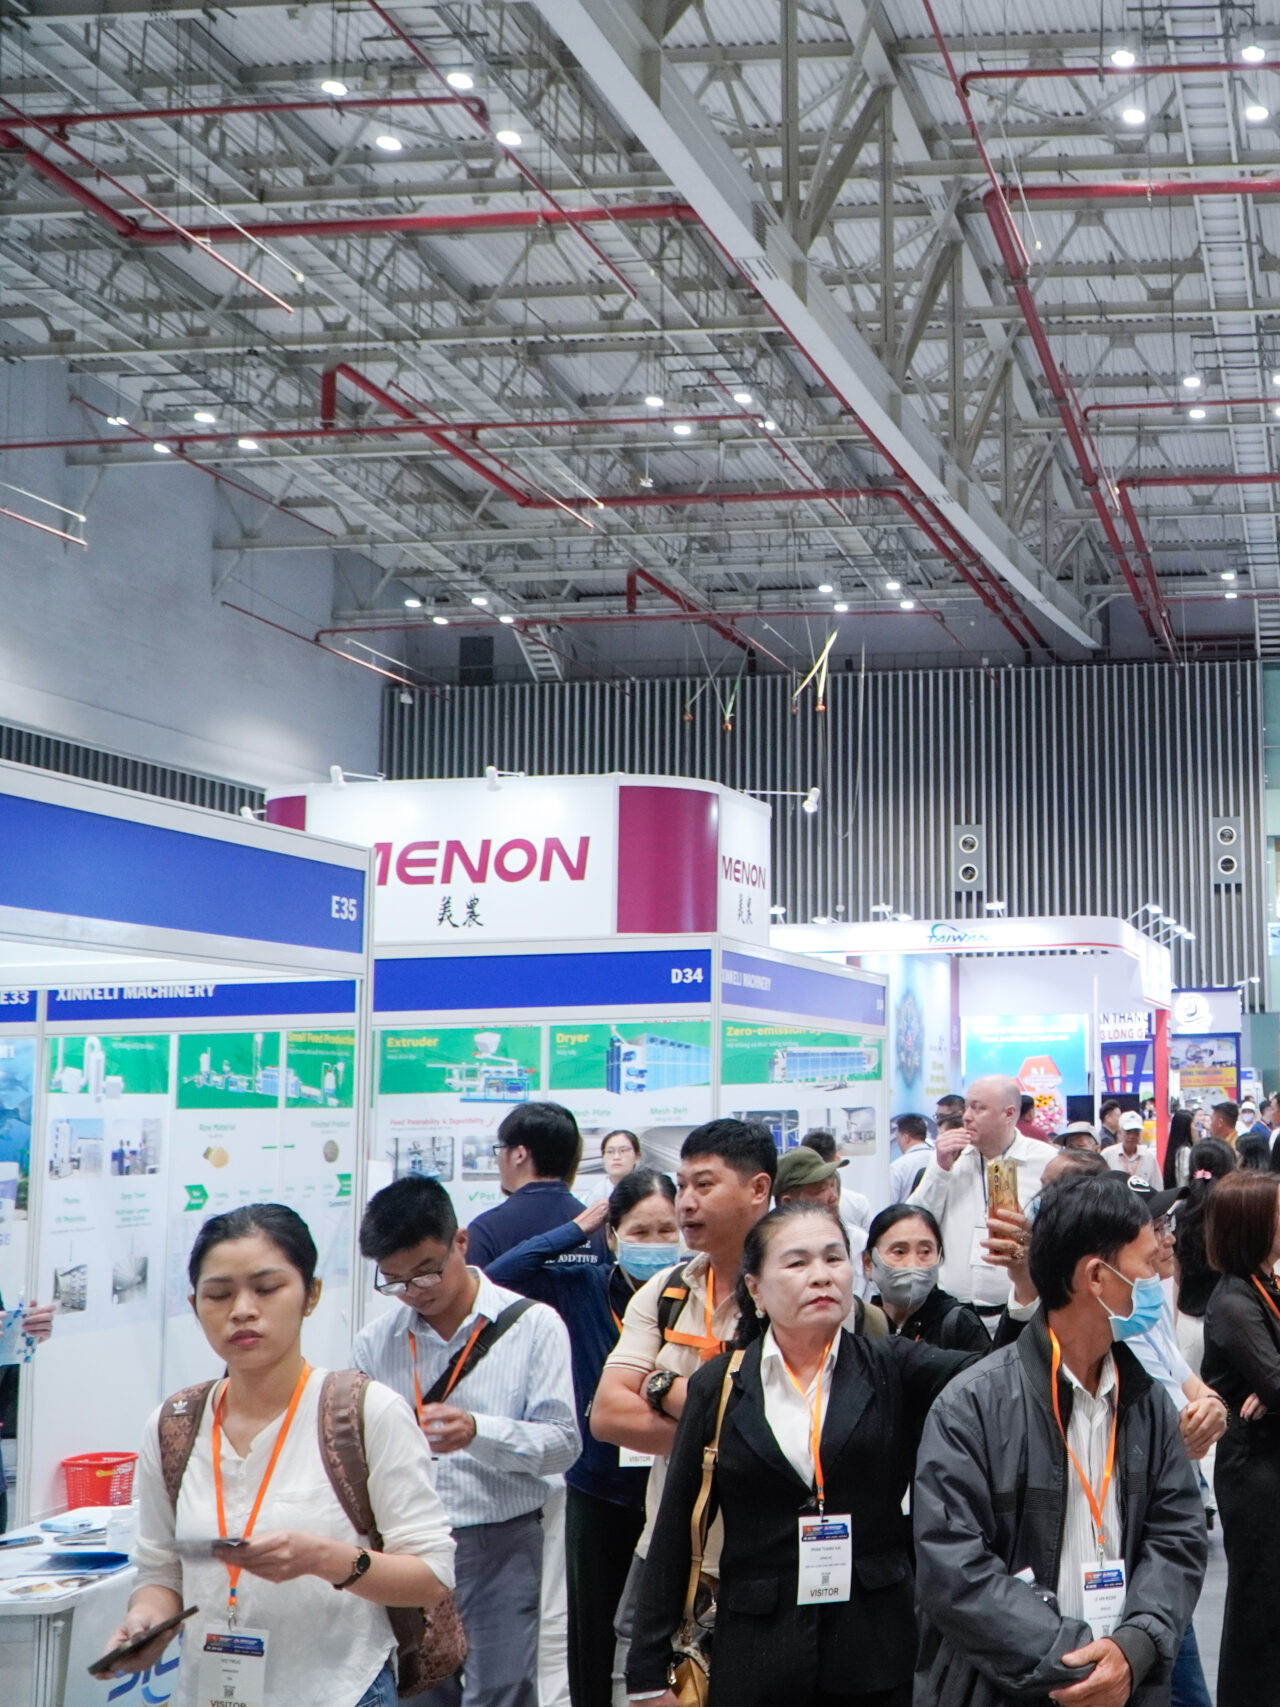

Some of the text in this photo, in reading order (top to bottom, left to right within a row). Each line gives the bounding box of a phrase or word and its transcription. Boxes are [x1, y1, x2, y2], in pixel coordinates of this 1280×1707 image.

[721, 855, 766, 890] MENON
[331, 895, 357, 922] E35
[671, 967, 704, 984] D34
[0, 990, 29, 1006] E33
[124, 984, 216, 1000] MACHINERY
[386, 1036, 439, 1048] Extruder
[555, 1033, 590, 1044] Dryer
[810, 1587, 839, 1598] VISITOR
[210, 1699, 247, 1707] VISITOR
